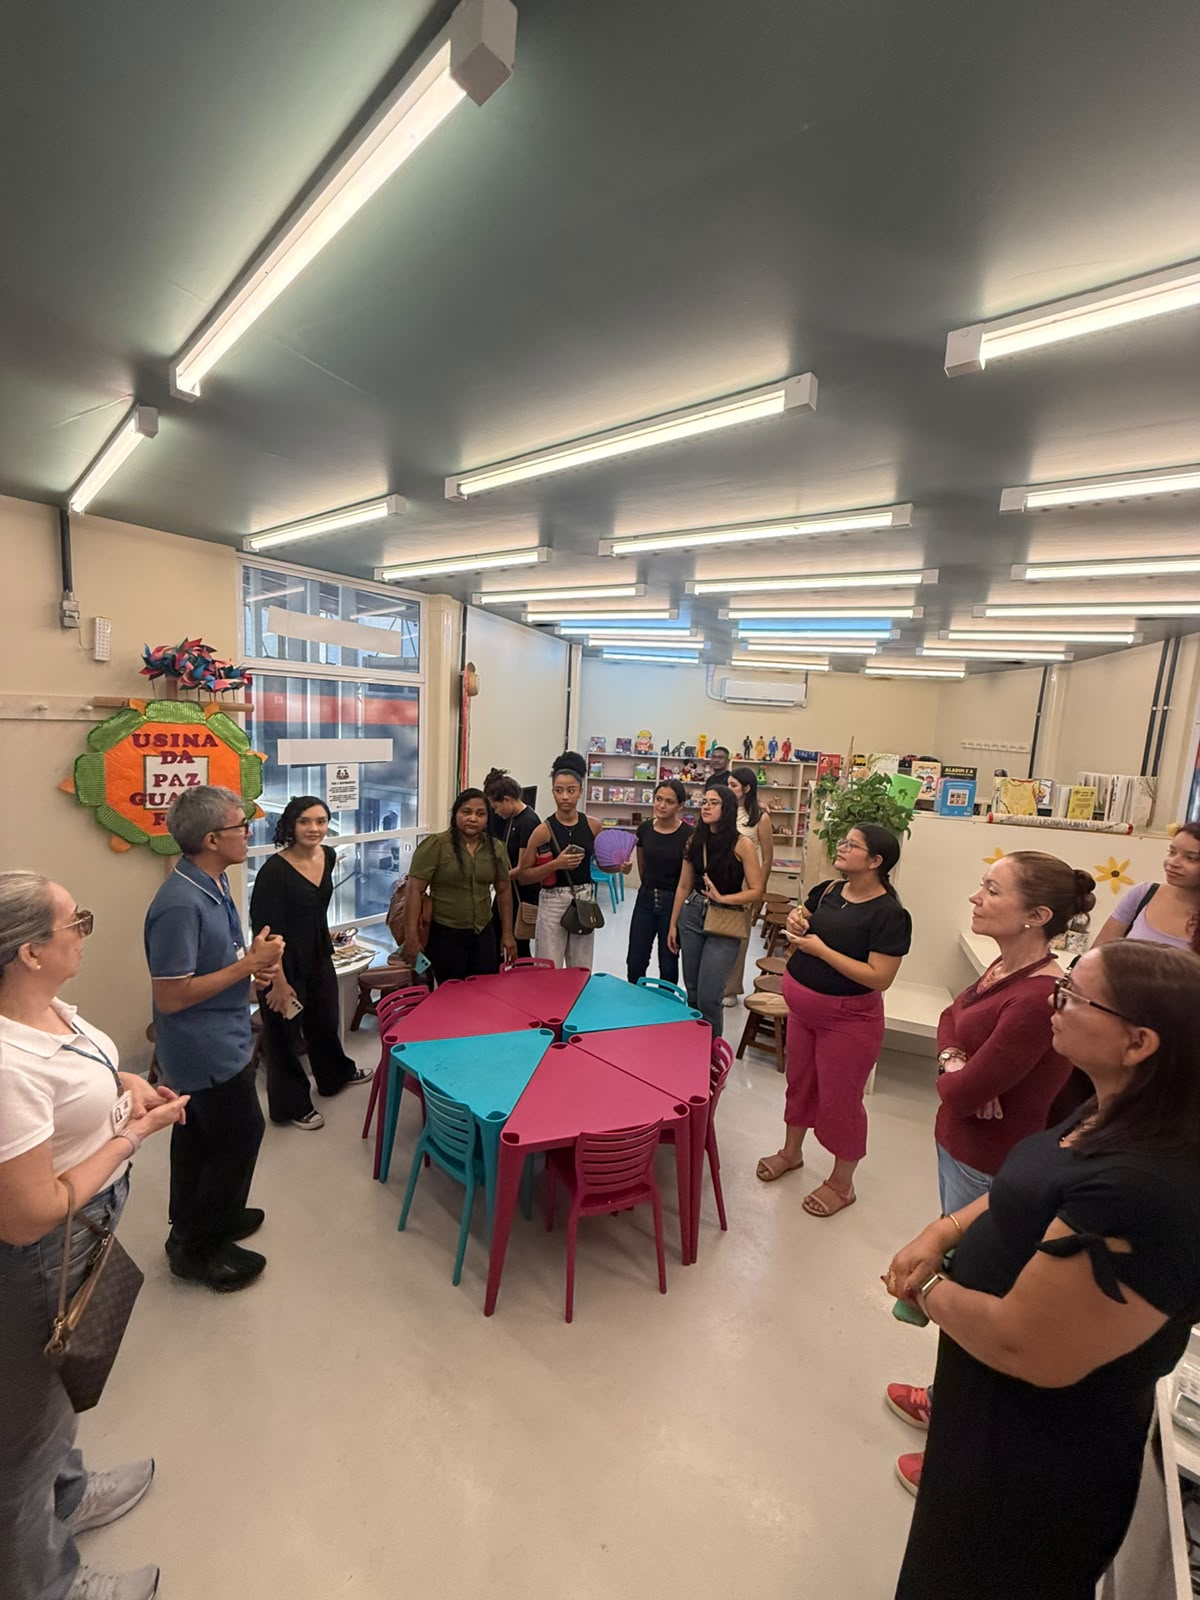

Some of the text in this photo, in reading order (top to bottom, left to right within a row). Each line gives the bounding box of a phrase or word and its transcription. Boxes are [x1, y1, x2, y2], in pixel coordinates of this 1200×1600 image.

[132, 733, 218, 748] USINA
[160, 750, 195, 765] DA
[153, 773, 201, 787] PAZ
[129, 791, 179, 806] GUA
